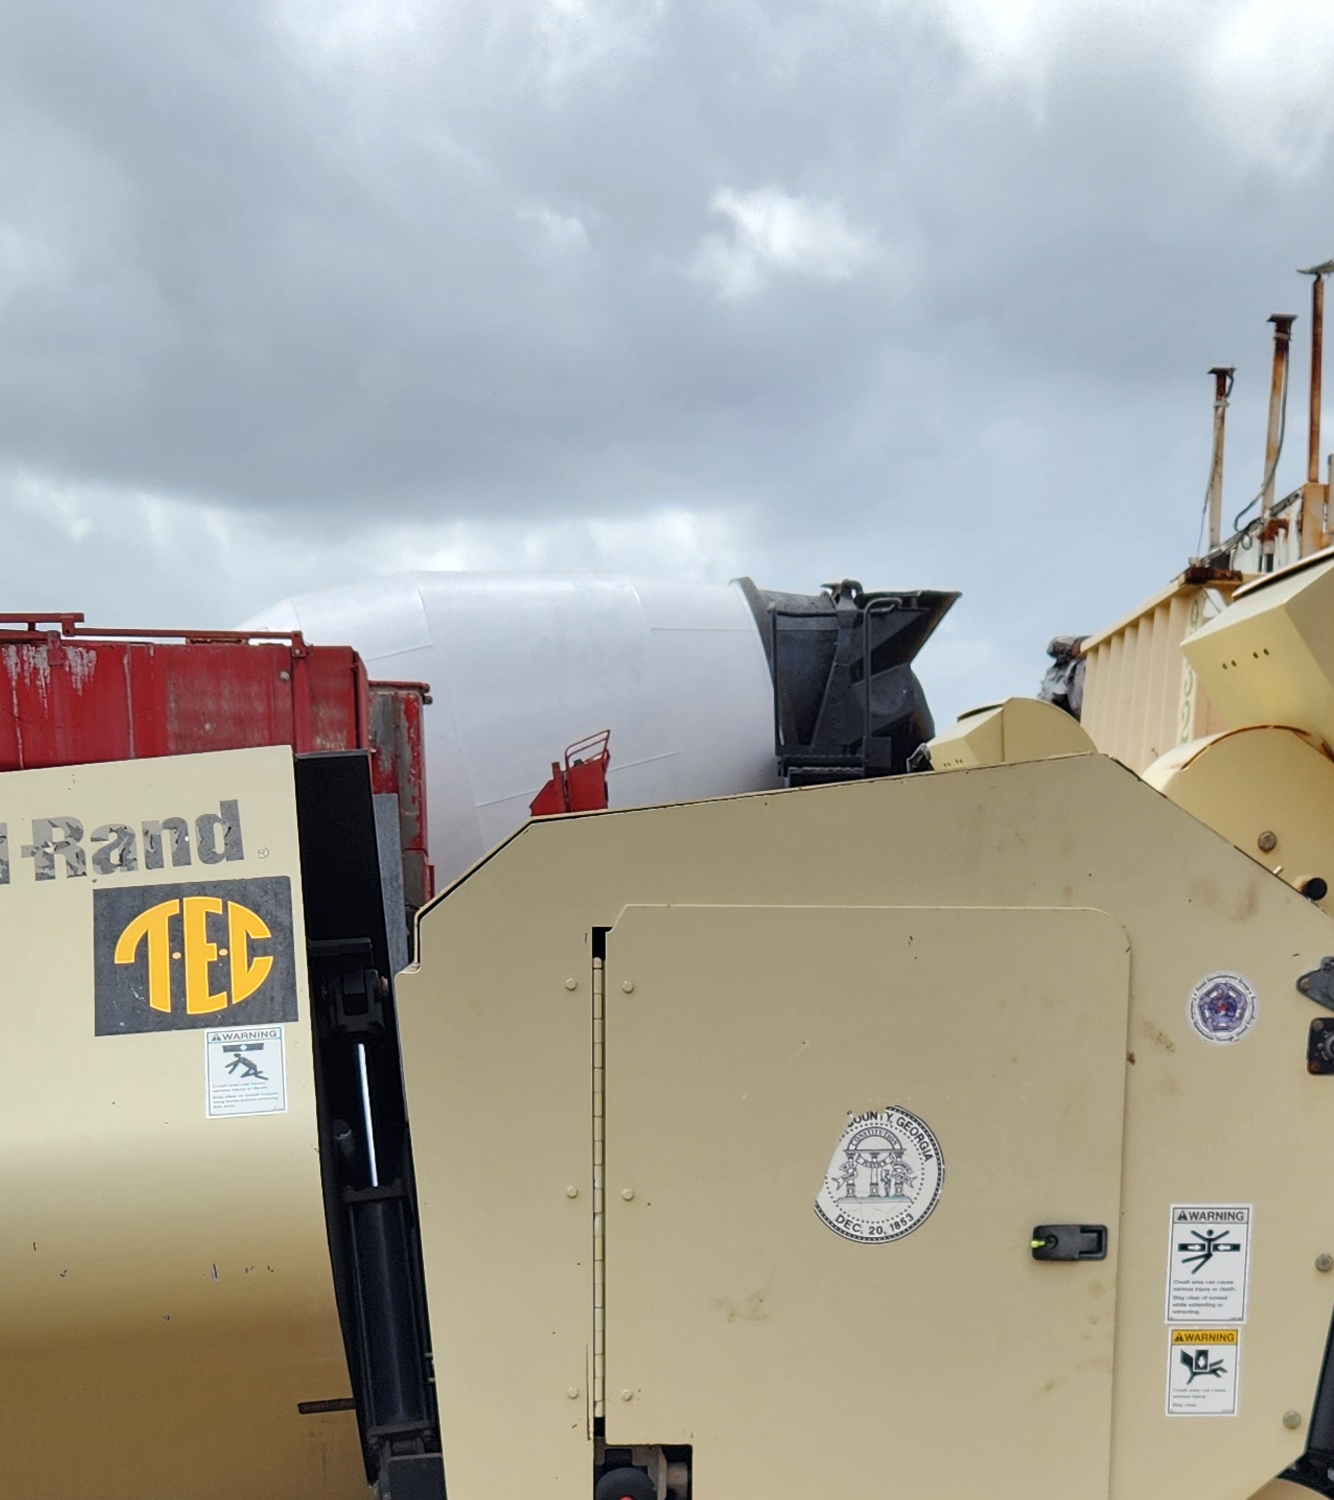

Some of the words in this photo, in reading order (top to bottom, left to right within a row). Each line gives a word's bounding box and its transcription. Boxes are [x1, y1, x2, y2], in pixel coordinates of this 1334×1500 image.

[222, 1029, 277, 1041] WARNING
[896, 1116, 934, 1163] GEORGIA
[1188, 1210, 1244, 1222] WARNING
[835, 1213, 864, 1235] DEC.
[868, 1225, 887, 1236] 20,
[889, 1212, 914, 1232] 1853
[1184, 1332, 1235, 1343] WARNING
